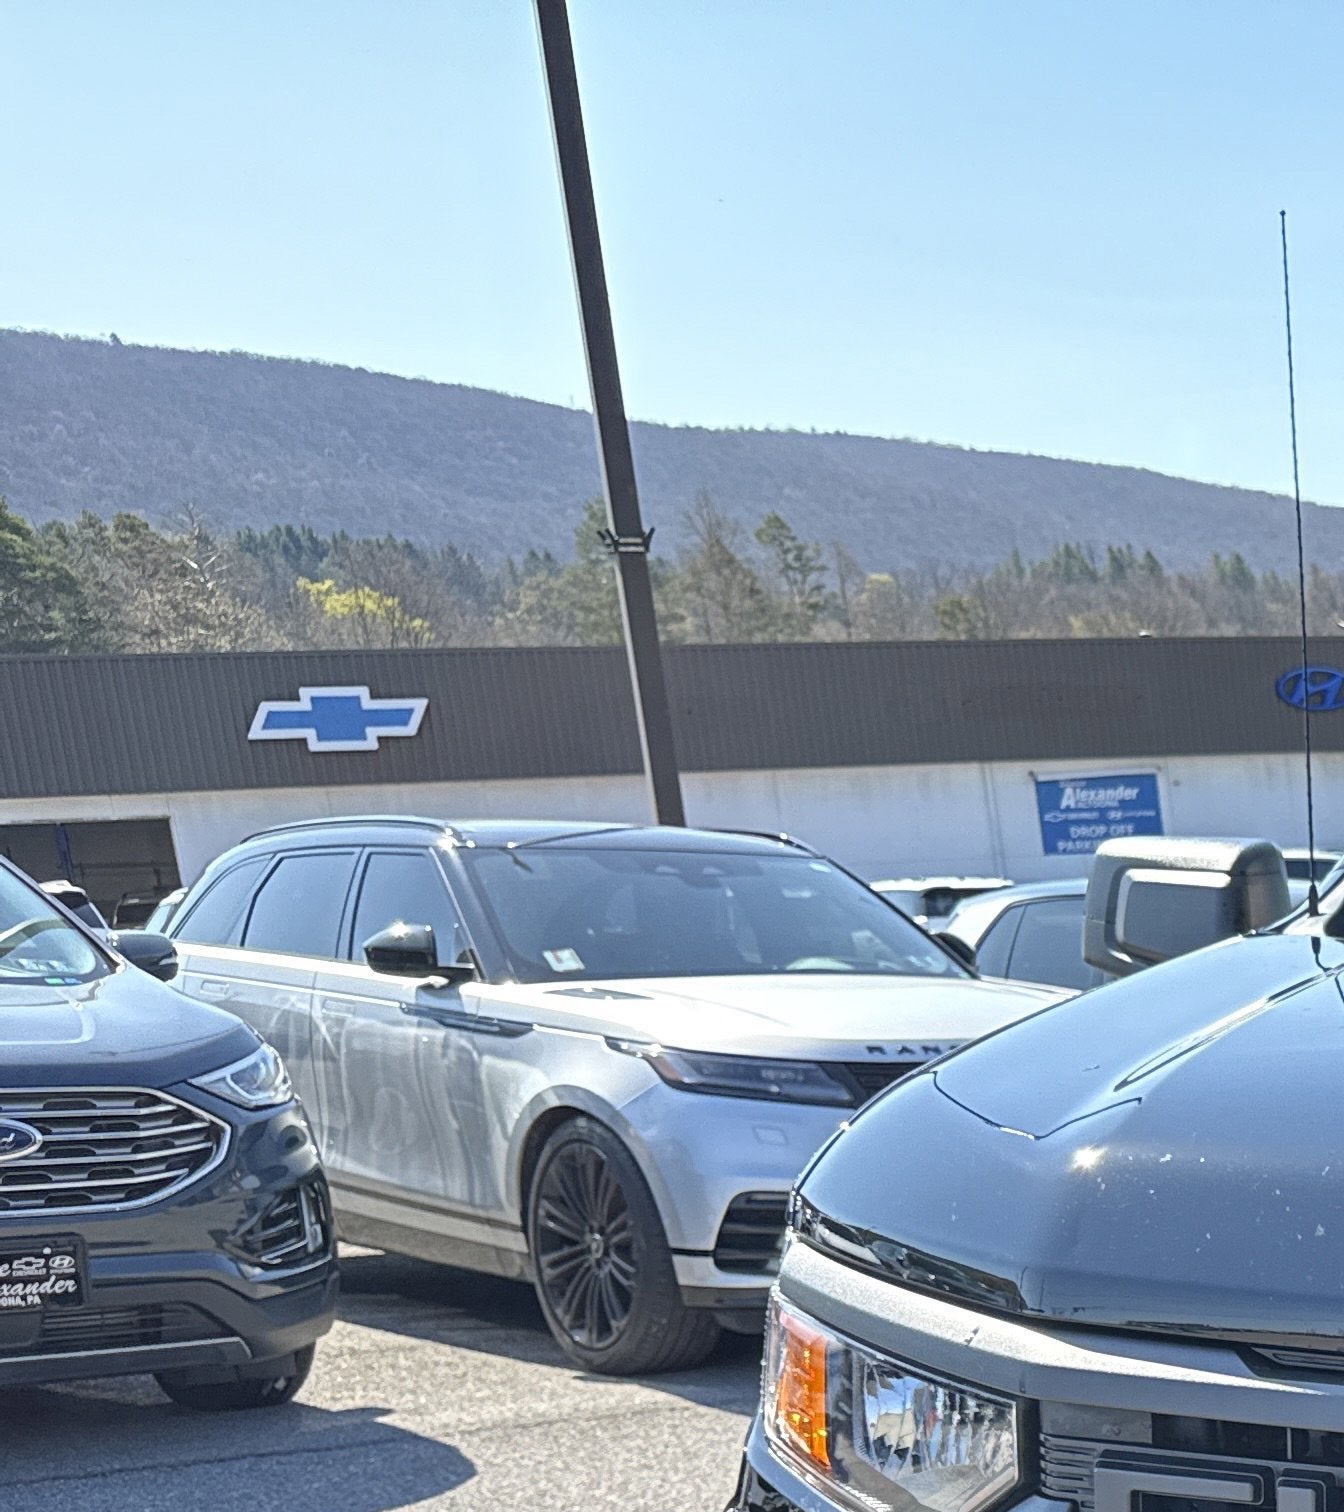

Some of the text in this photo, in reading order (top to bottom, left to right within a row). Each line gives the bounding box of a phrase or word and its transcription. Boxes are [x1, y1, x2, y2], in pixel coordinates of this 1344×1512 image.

[1060, 786, 1140, 809] Alexander
[1069, 822, 1135, 838] DROP OFF
[26, 1294, 41, 1306] PA
